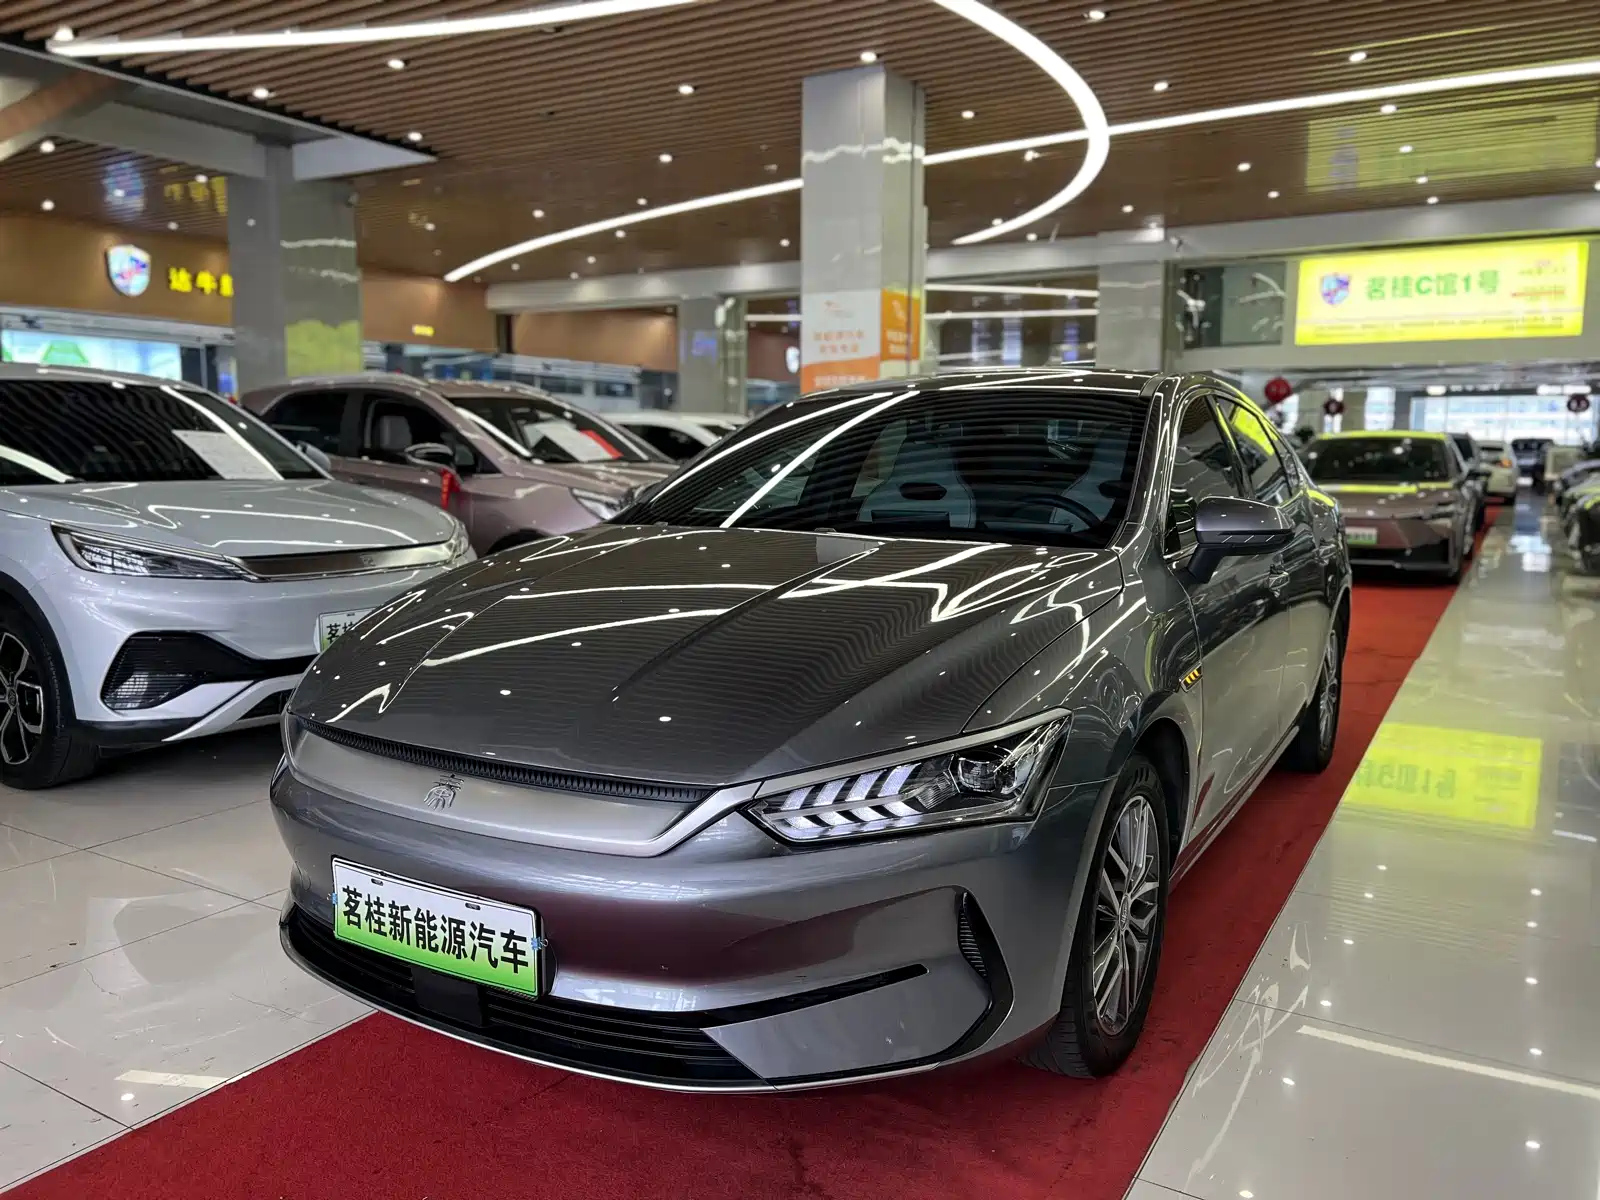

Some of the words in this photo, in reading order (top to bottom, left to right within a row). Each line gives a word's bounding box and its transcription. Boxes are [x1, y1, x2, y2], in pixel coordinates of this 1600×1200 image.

[342, 885, 529, 974] 茗桂新能源汽车
